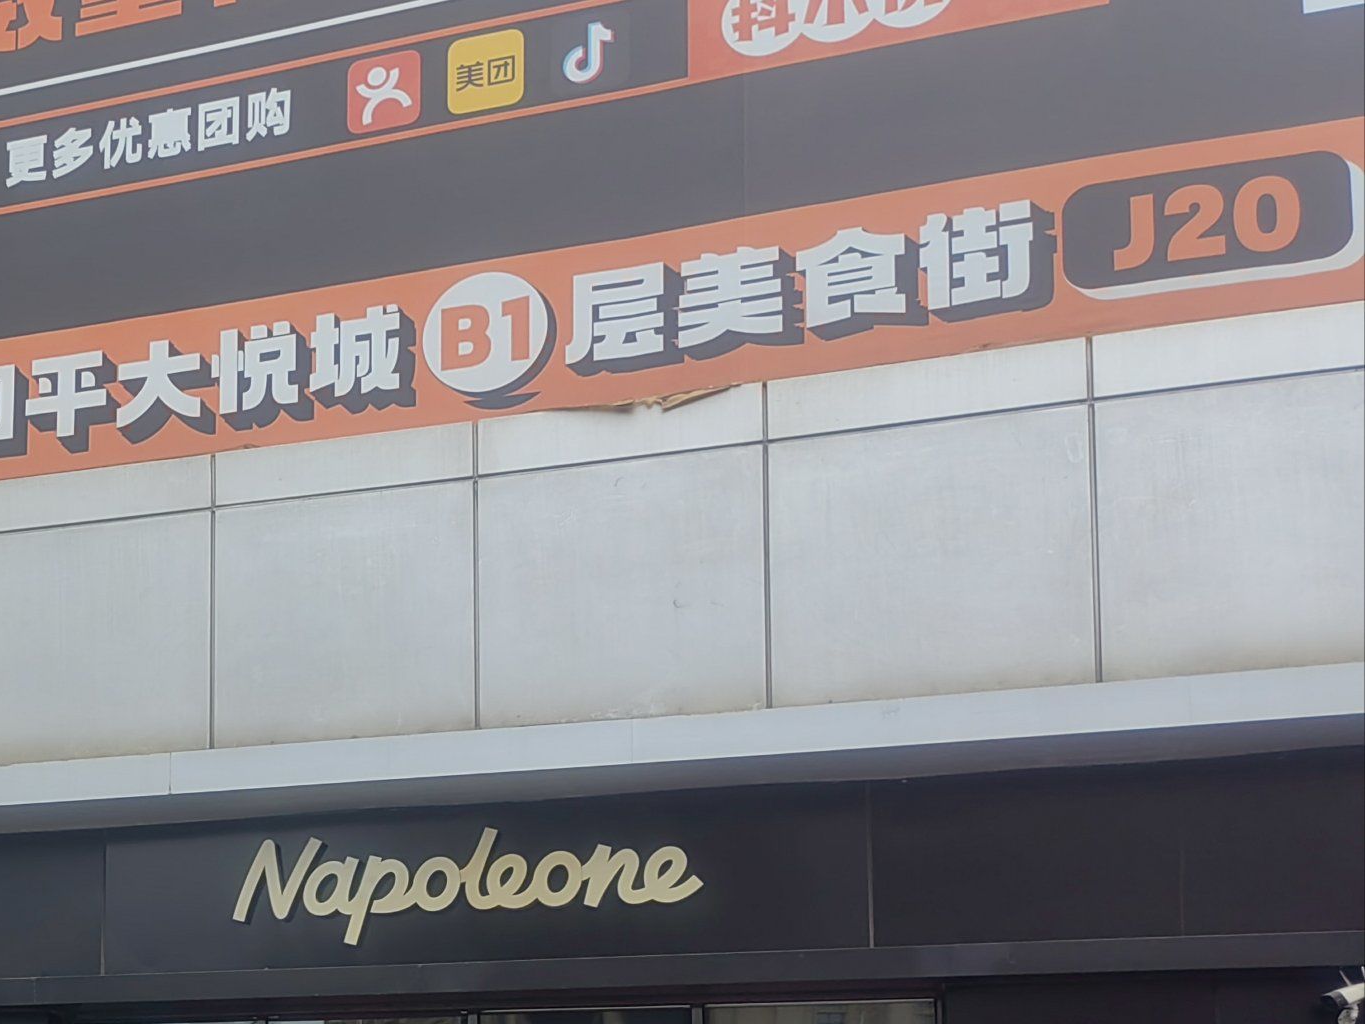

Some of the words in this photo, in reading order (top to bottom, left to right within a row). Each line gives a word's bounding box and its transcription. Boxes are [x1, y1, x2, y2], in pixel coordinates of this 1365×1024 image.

[455, 54, 516, 92] 美团
[5, 87, 293, 188] 更多优惠团购
[439, 294, 531, 371] B1
[564, 198, 1036, 368] 层美食街
[1112, 174, 1303, 272] J20
[233, 826, 705, 946] Napoleone
